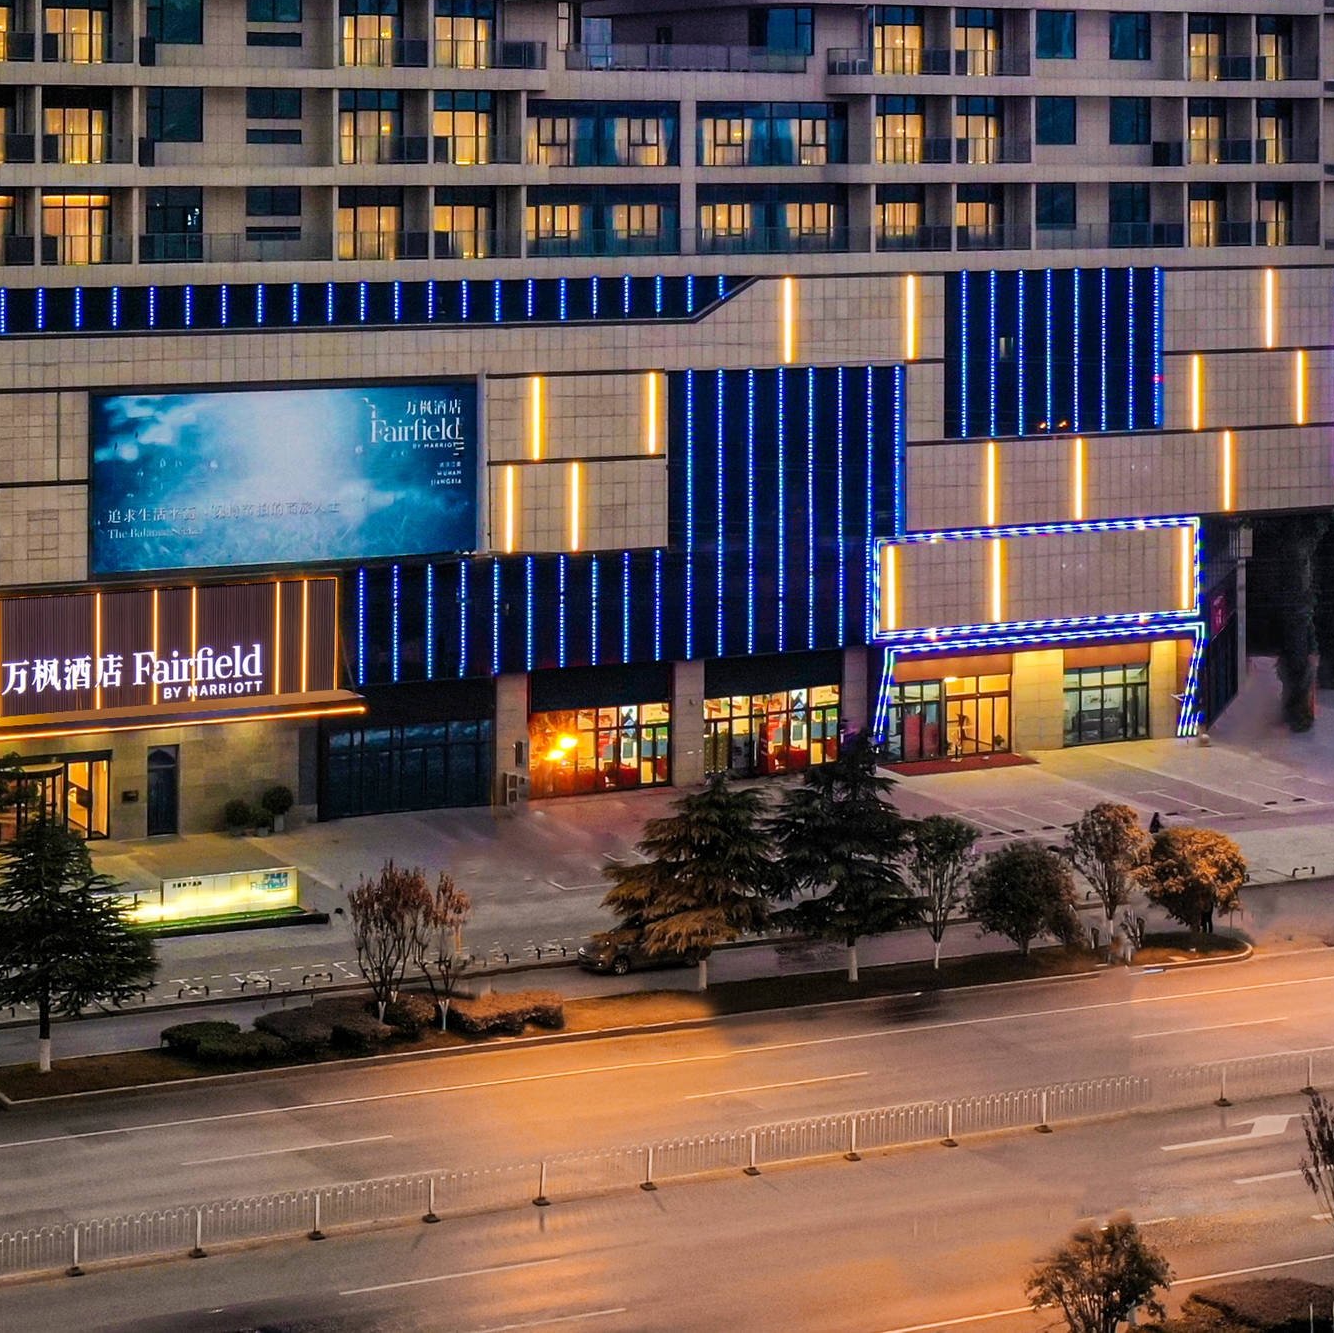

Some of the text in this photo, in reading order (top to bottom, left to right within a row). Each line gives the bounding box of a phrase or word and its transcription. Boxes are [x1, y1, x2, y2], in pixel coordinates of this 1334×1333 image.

[370, 417, 464, 443] Fairfield
[1, 644, 263, 695] 万枫酒店 Fairfield
[163, 680, 263, 699] BY MARRIOTT
